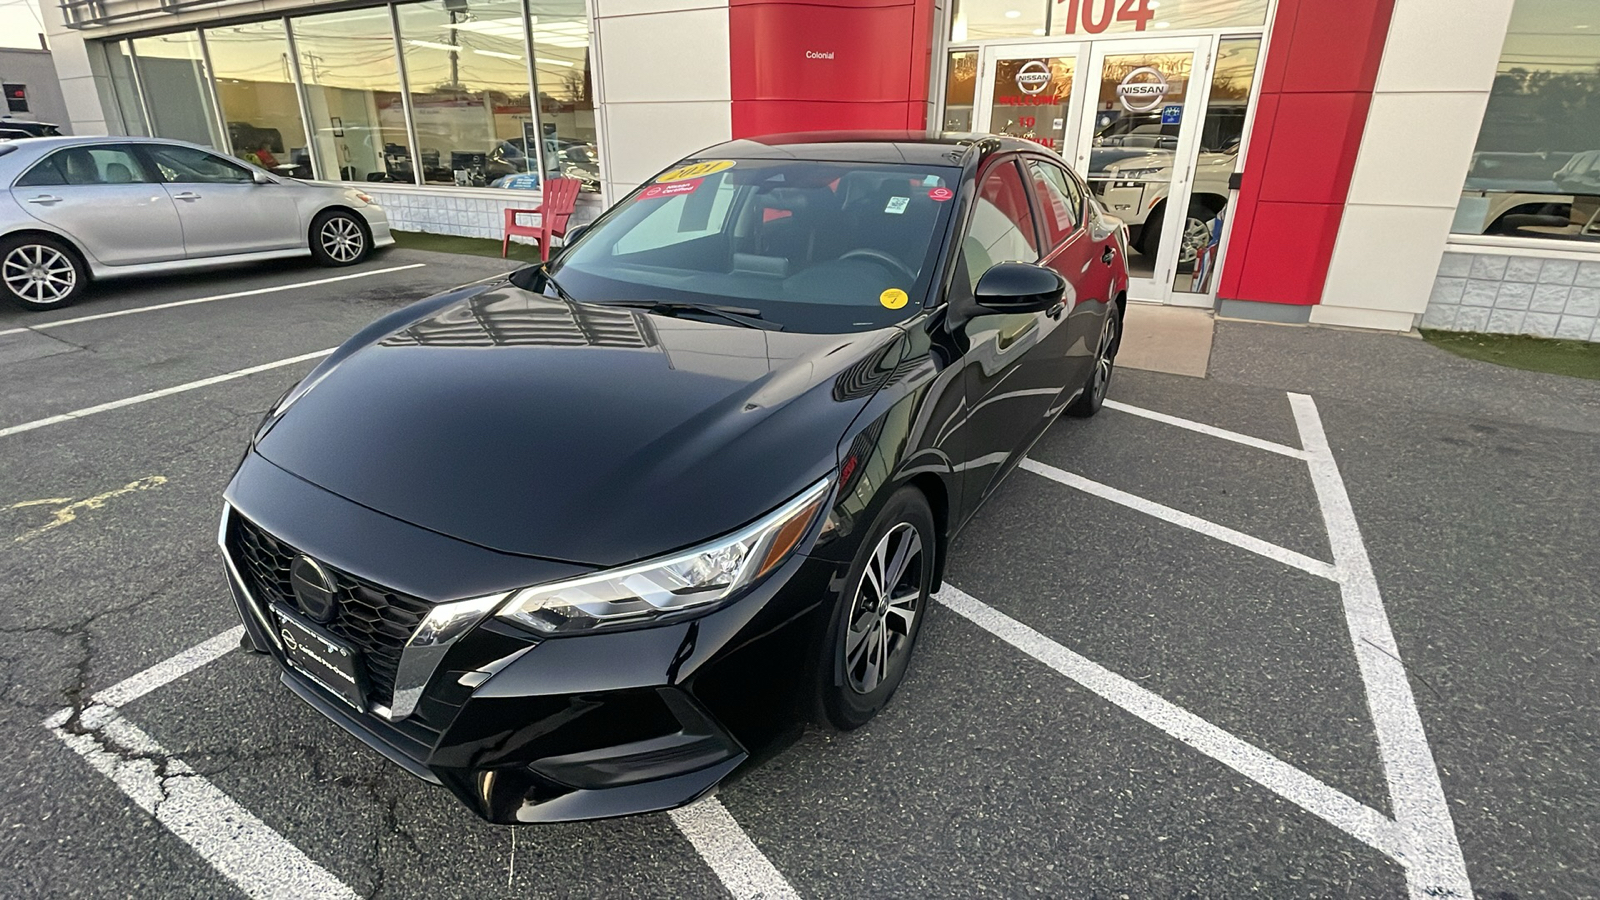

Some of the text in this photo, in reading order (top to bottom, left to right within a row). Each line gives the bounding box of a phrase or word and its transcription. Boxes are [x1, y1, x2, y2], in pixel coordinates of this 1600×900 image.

[1058, 0, 1155, 34] 104
[806, 50, 835, 59] Colonial
[1121, 86, 1164, 94] NISSAN
[999, 95, 1061, 105] WELCOME
[1019, 116, 1036, 127] TO
[666, 162, 723, 180] 2021
[662, 186, 694, 194] Certified
